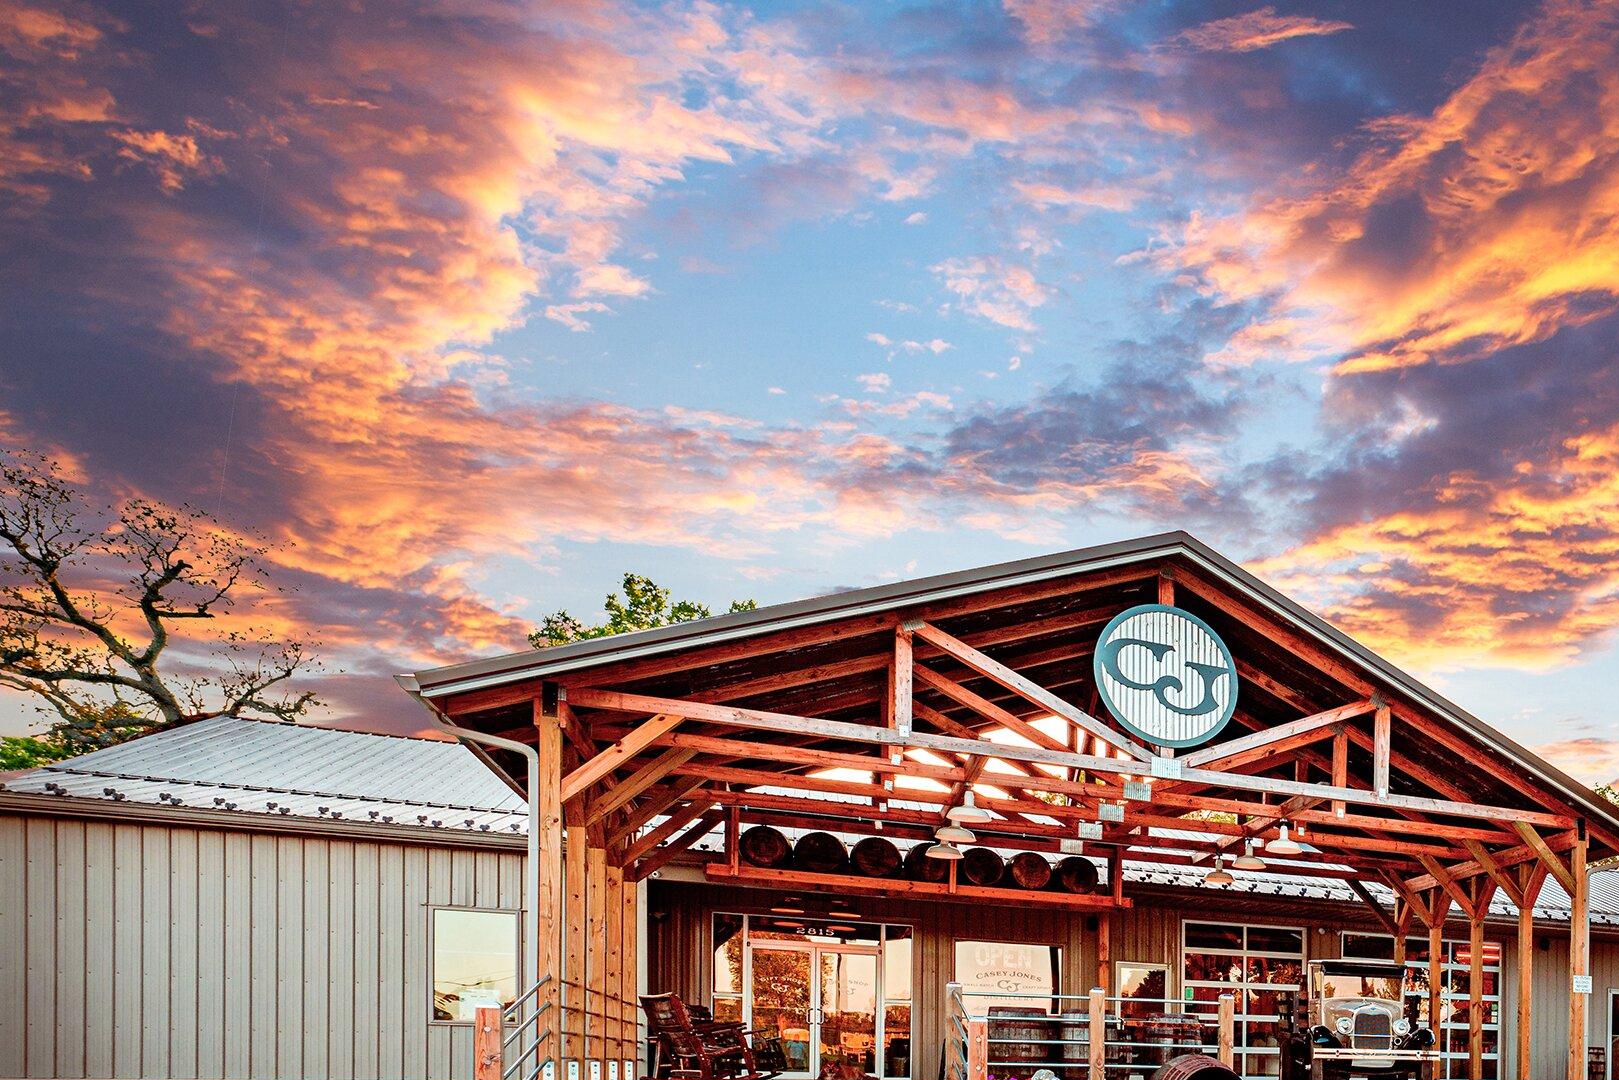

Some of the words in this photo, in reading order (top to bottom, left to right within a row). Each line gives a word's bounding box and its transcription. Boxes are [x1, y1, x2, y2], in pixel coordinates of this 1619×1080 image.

[796, 927, 836, 936] 2815
[974, 943, 1032, 968] OPEN
[976, 971, 1009, 980] CASEY
[1009, 971, 1042, 982] JONES
